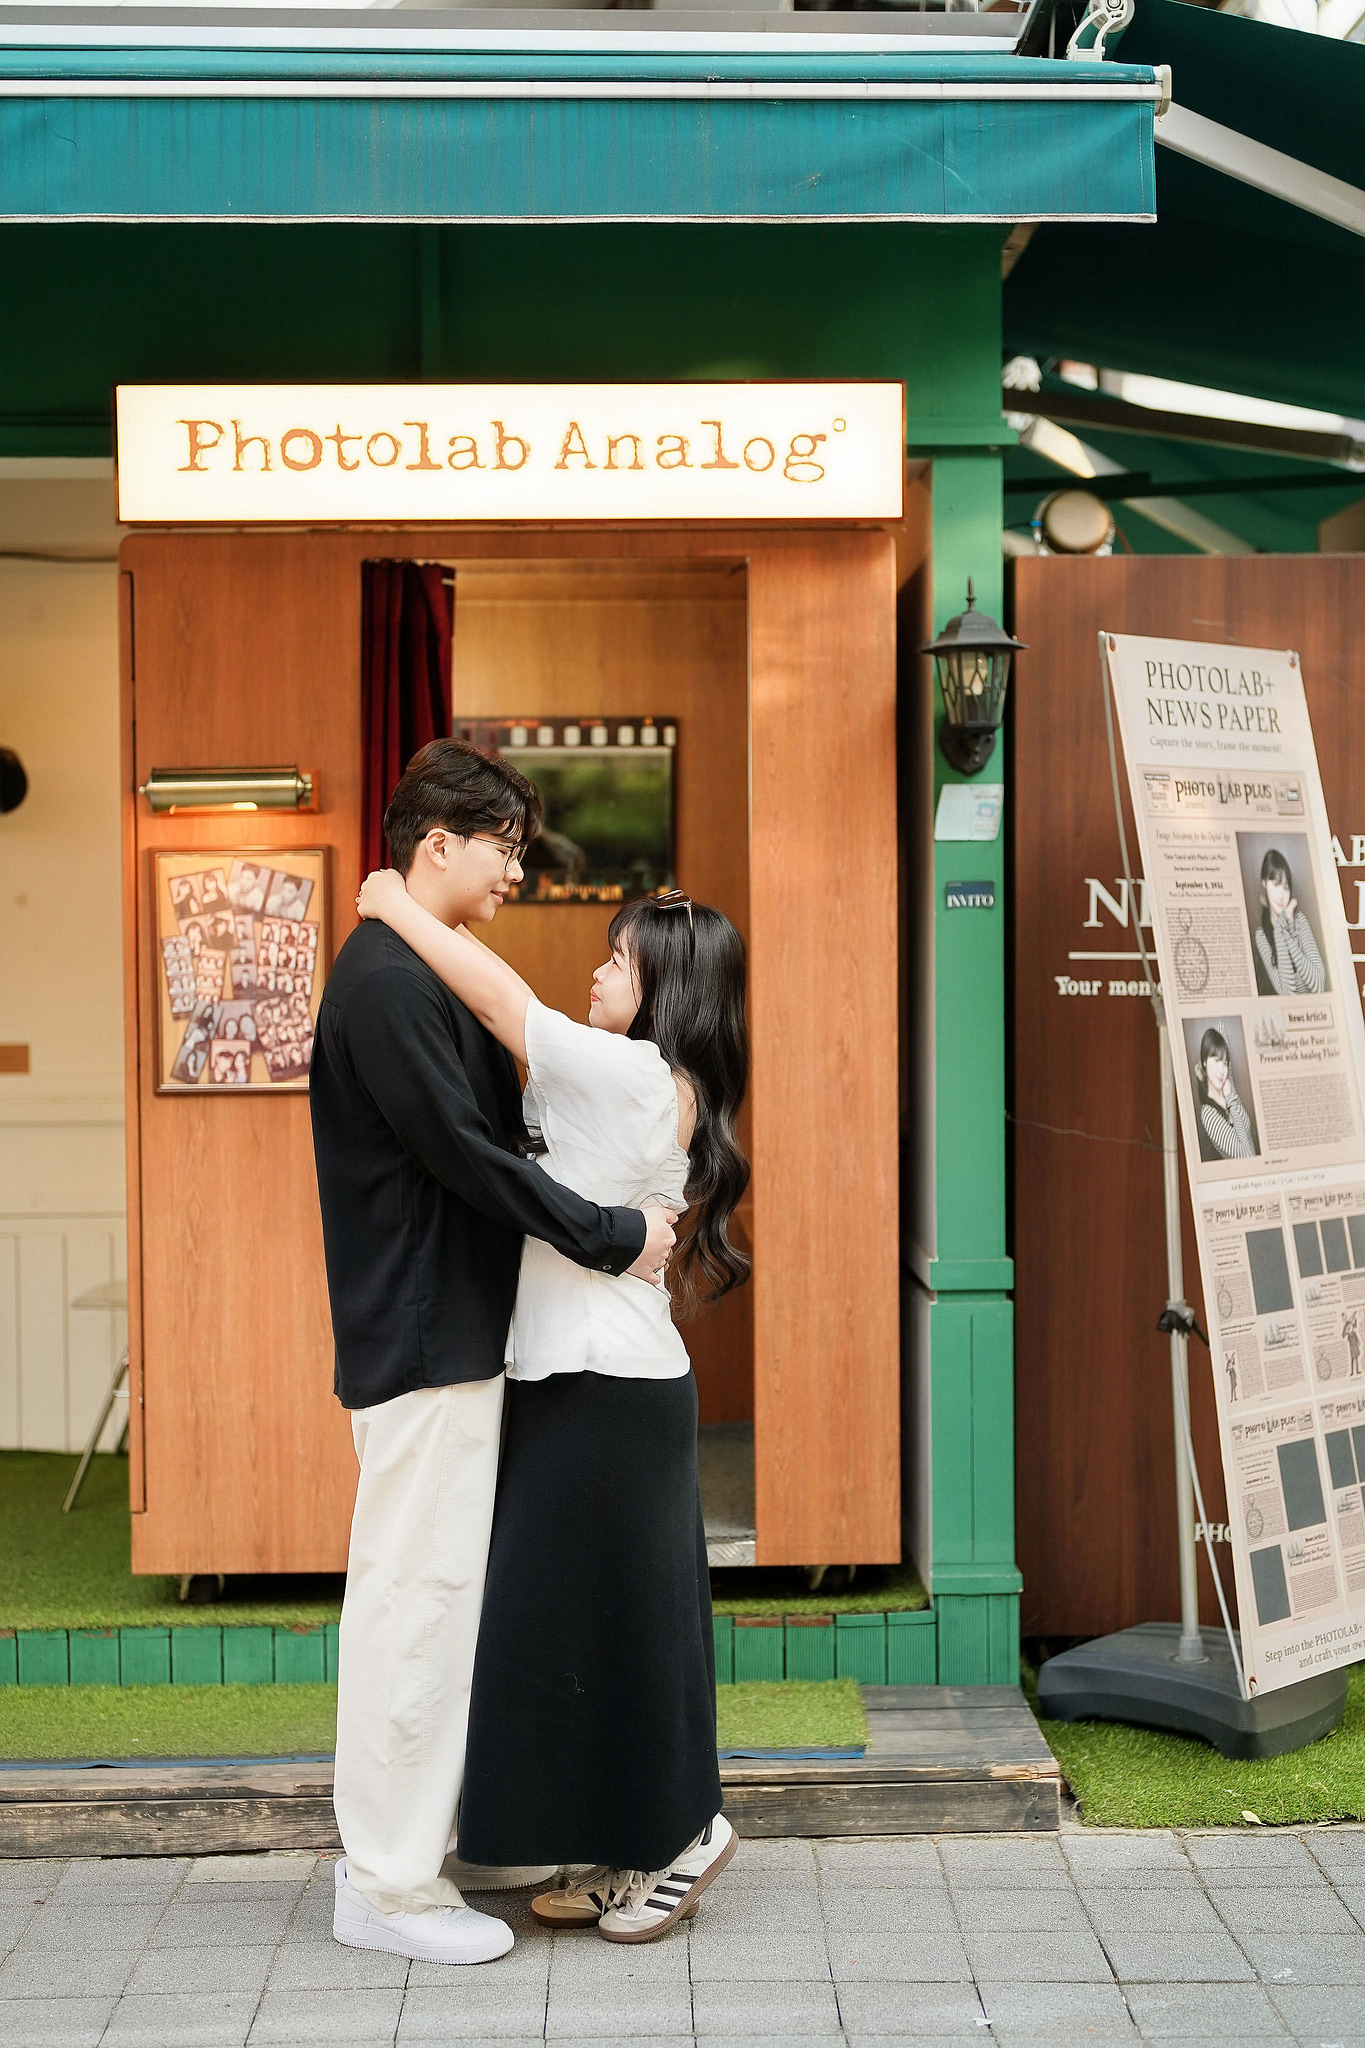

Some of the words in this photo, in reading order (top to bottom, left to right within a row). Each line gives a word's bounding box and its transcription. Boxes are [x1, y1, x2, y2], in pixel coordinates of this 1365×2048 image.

[176, 419, 531, 473] Photolab
[1144, 660, 1276, 698] PHOTOLAB+
[1146, 697, 1213, 730] NEWS
[1217, 700, 1282, 734] PAPER
[1150, 736, 1180, 750] Capture
[1181, 738, 1193, 749] the
[1239, 741, 1250, 752] the
[1054, 975, 1103, 996] Your
[1288, 1013, 1305, 1023] News
[1306, 1010, 1328, 1022] Article
[1285, 1050, 1298, 1061] with
[1264, 1649, 1283, 1663] Step
[1284, 1644, 1301, 1657] into
[1301, 1638, 1314, 1651] the
[1298, 1653, 1313, 1669] and
[1314, 1647, 1333, 1664] craft
[1333, 1643, 1351, 1660] your
